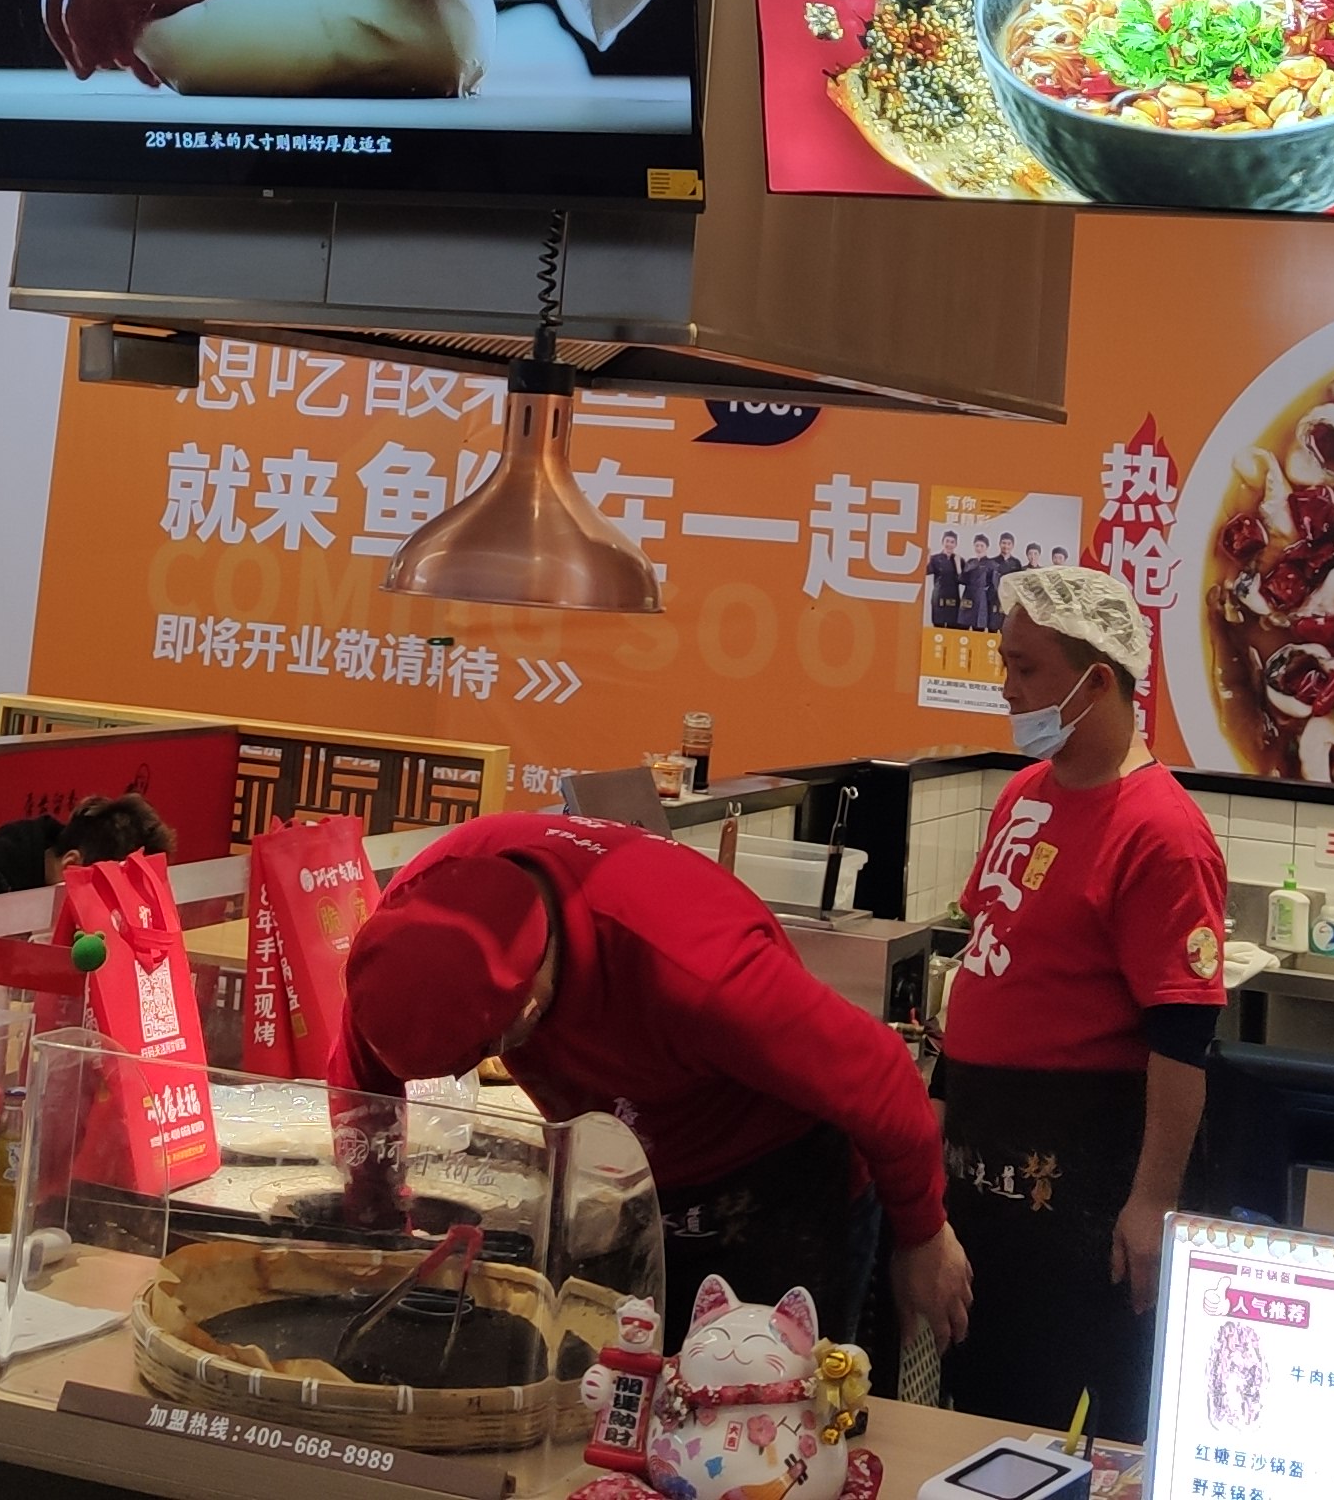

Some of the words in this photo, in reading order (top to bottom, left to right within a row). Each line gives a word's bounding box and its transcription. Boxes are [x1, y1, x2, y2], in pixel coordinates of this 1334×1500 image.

[1232, 1295, 1307, 1324] 人气推荐
[1194, 1443, 1305, 1479] 红糖豆沙锅盔
